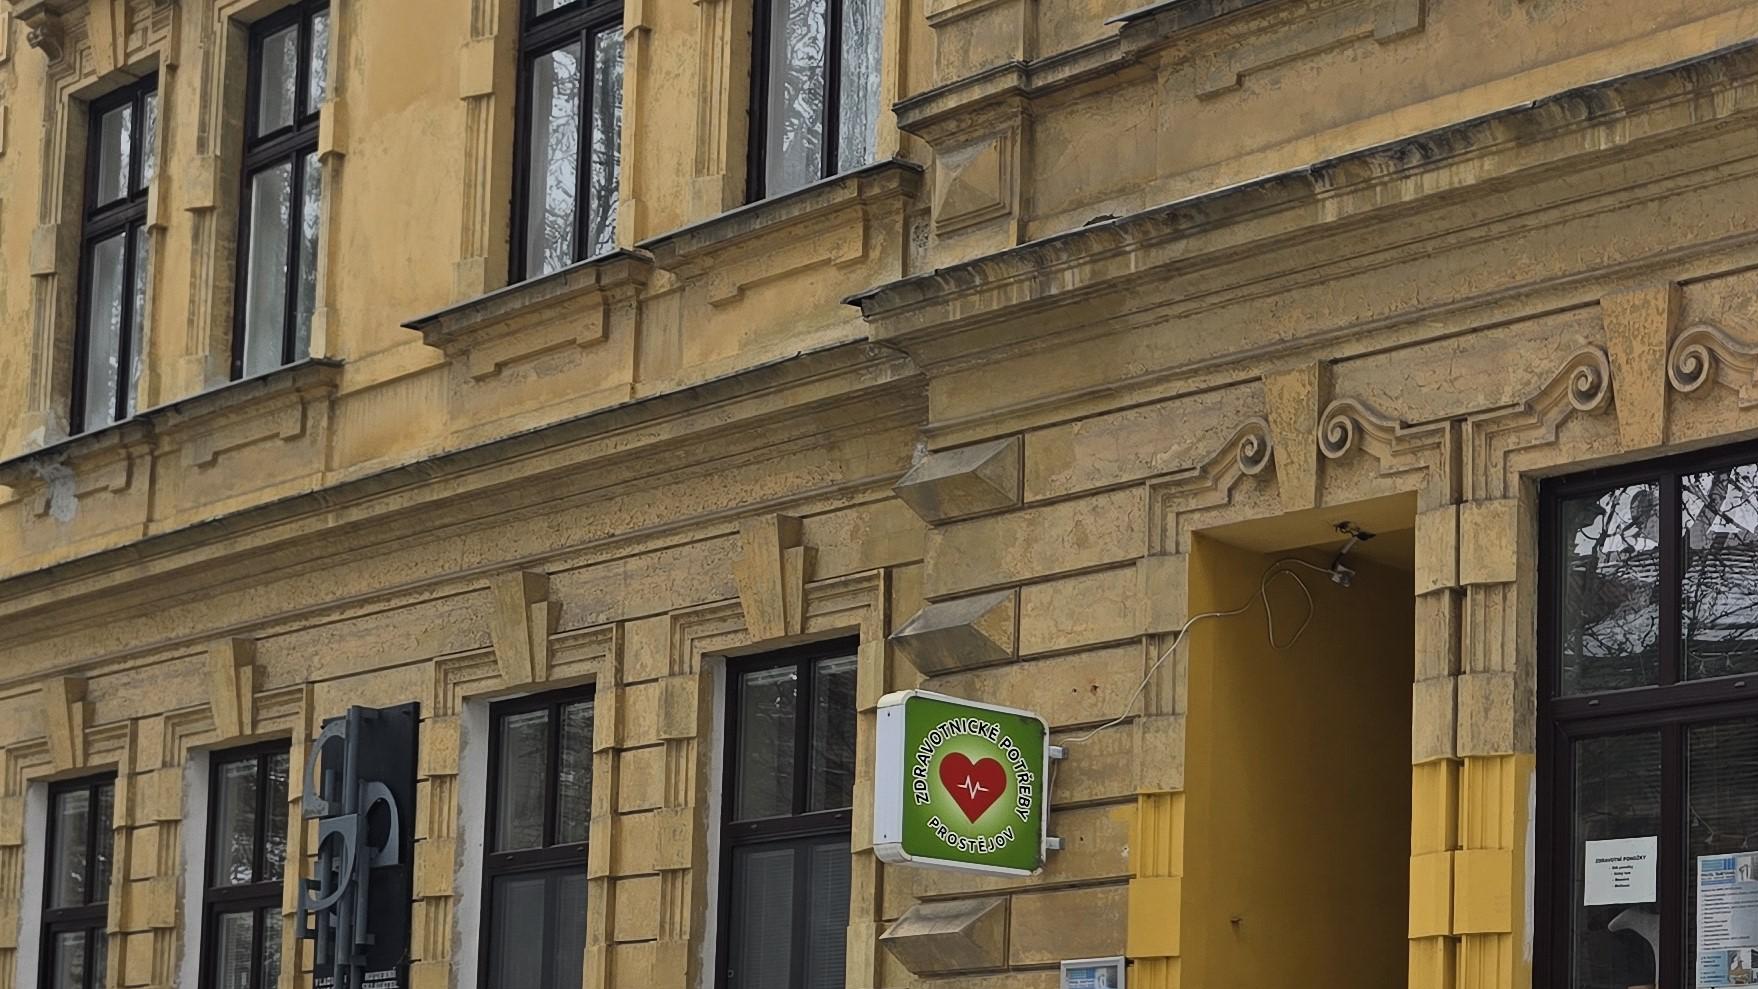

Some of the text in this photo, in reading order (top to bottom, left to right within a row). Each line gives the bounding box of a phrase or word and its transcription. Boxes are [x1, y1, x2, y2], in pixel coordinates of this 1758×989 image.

[913, 718, 1034, 822] ZDRAVOTNICKÉ POTŘEBY
[928, 816, 1016, 854] PROSTĚJOV
